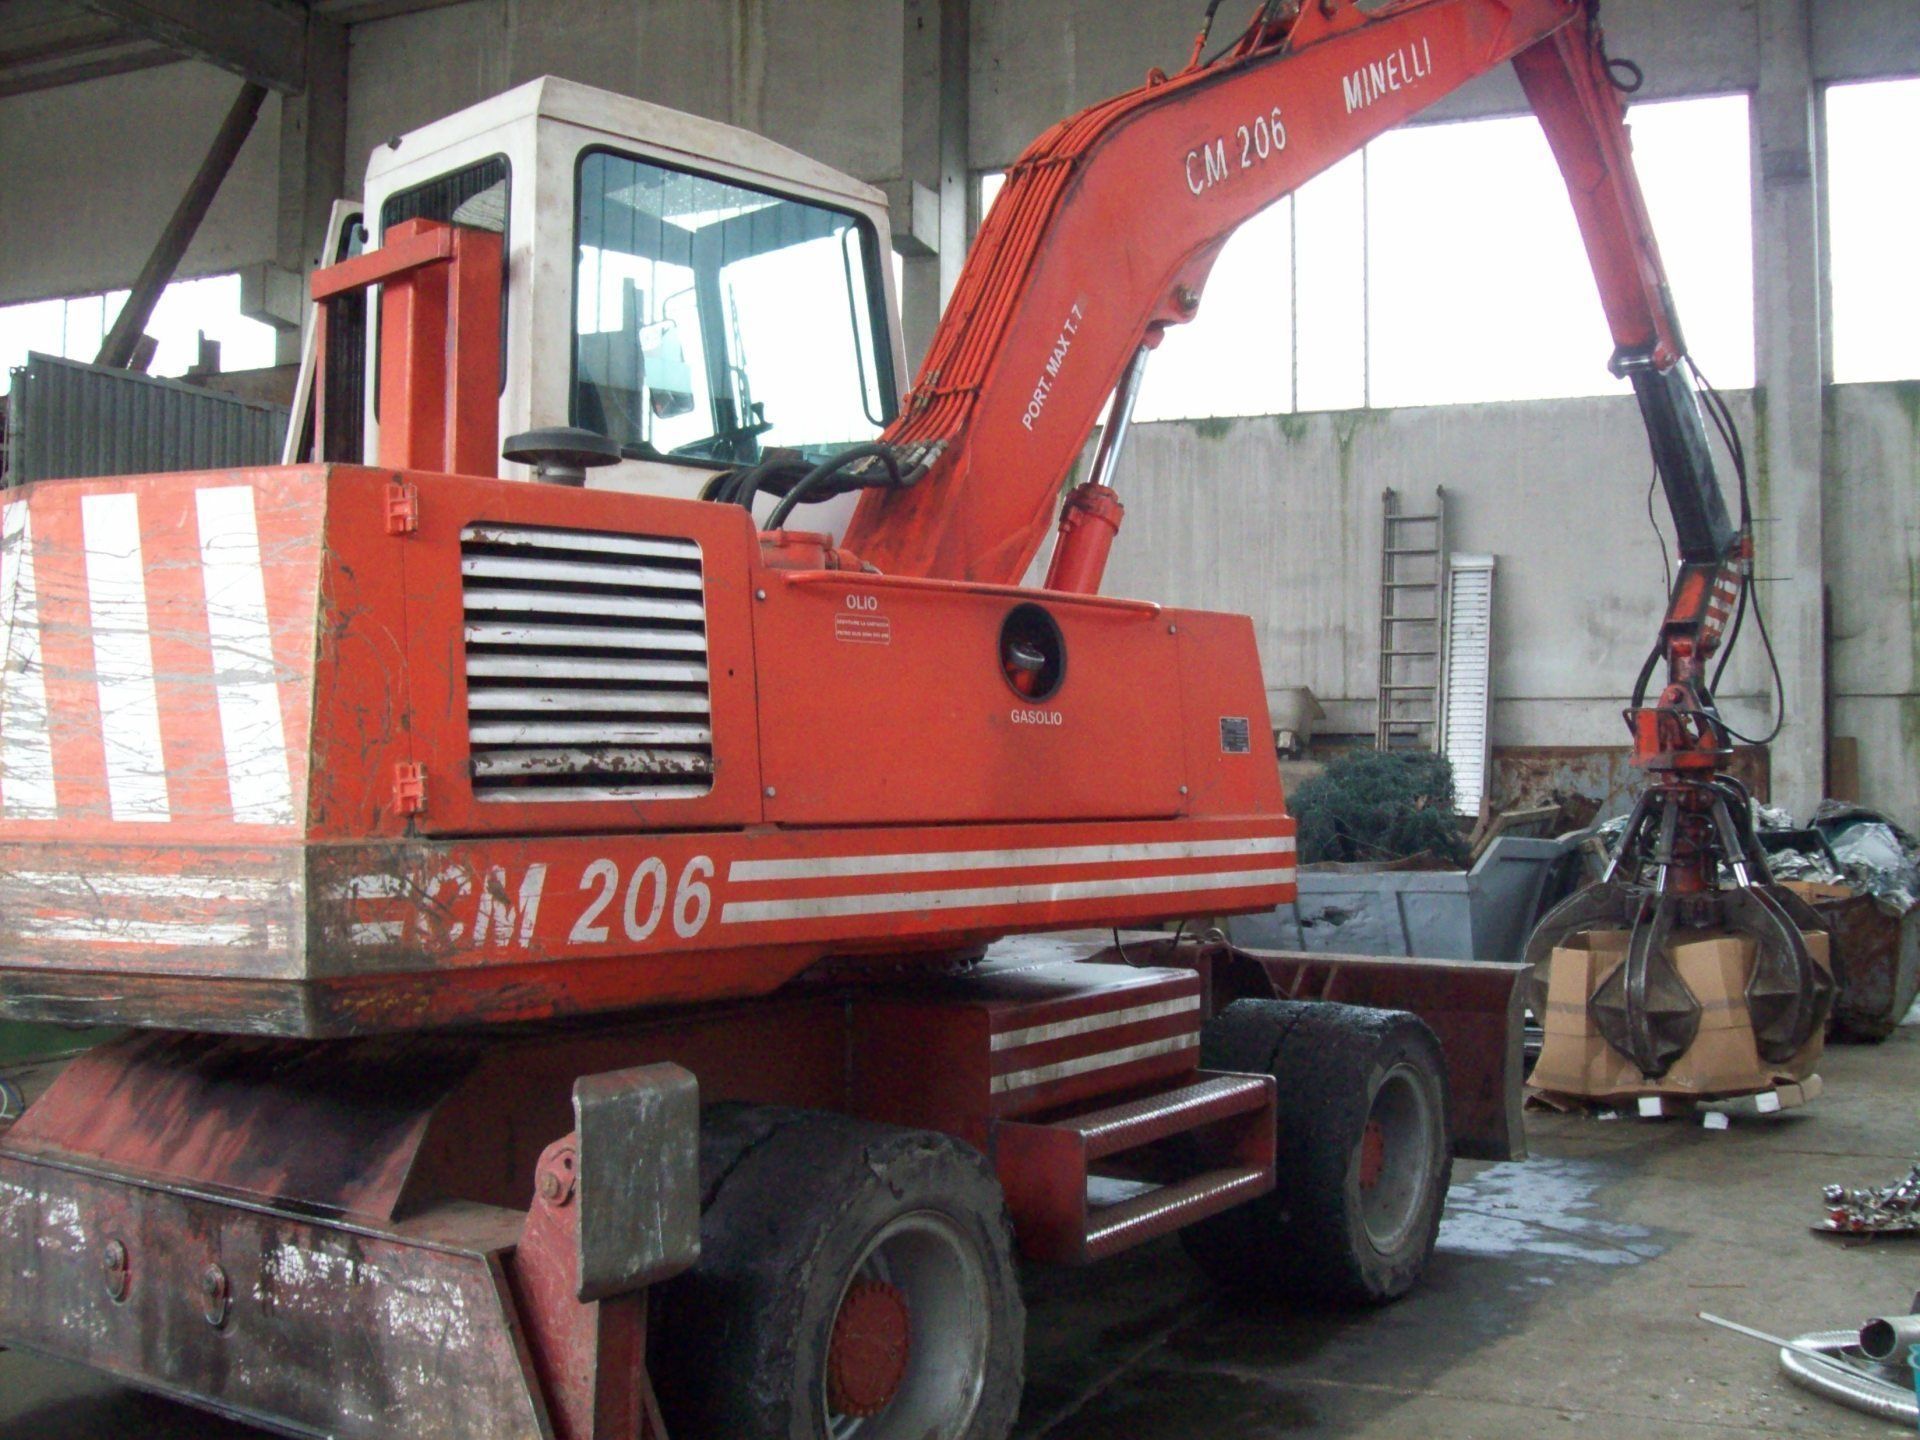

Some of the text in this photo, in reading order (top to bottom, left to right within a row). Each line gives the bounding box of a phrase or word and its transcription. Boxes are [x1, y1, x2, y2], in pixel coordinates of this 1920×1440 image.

[1343, 37, 1431, 114] MINELLI
[1185, 107, 1286, 195] CM 206
[1022, 376, 1052, 432] PORT.
[1045, 333, 1071, 378] MAX
[846, 594, 878, 611] OLIO
[1011, 709, 1063, 726] GASOLIO
[415, 854, 715, 948] CM 206
